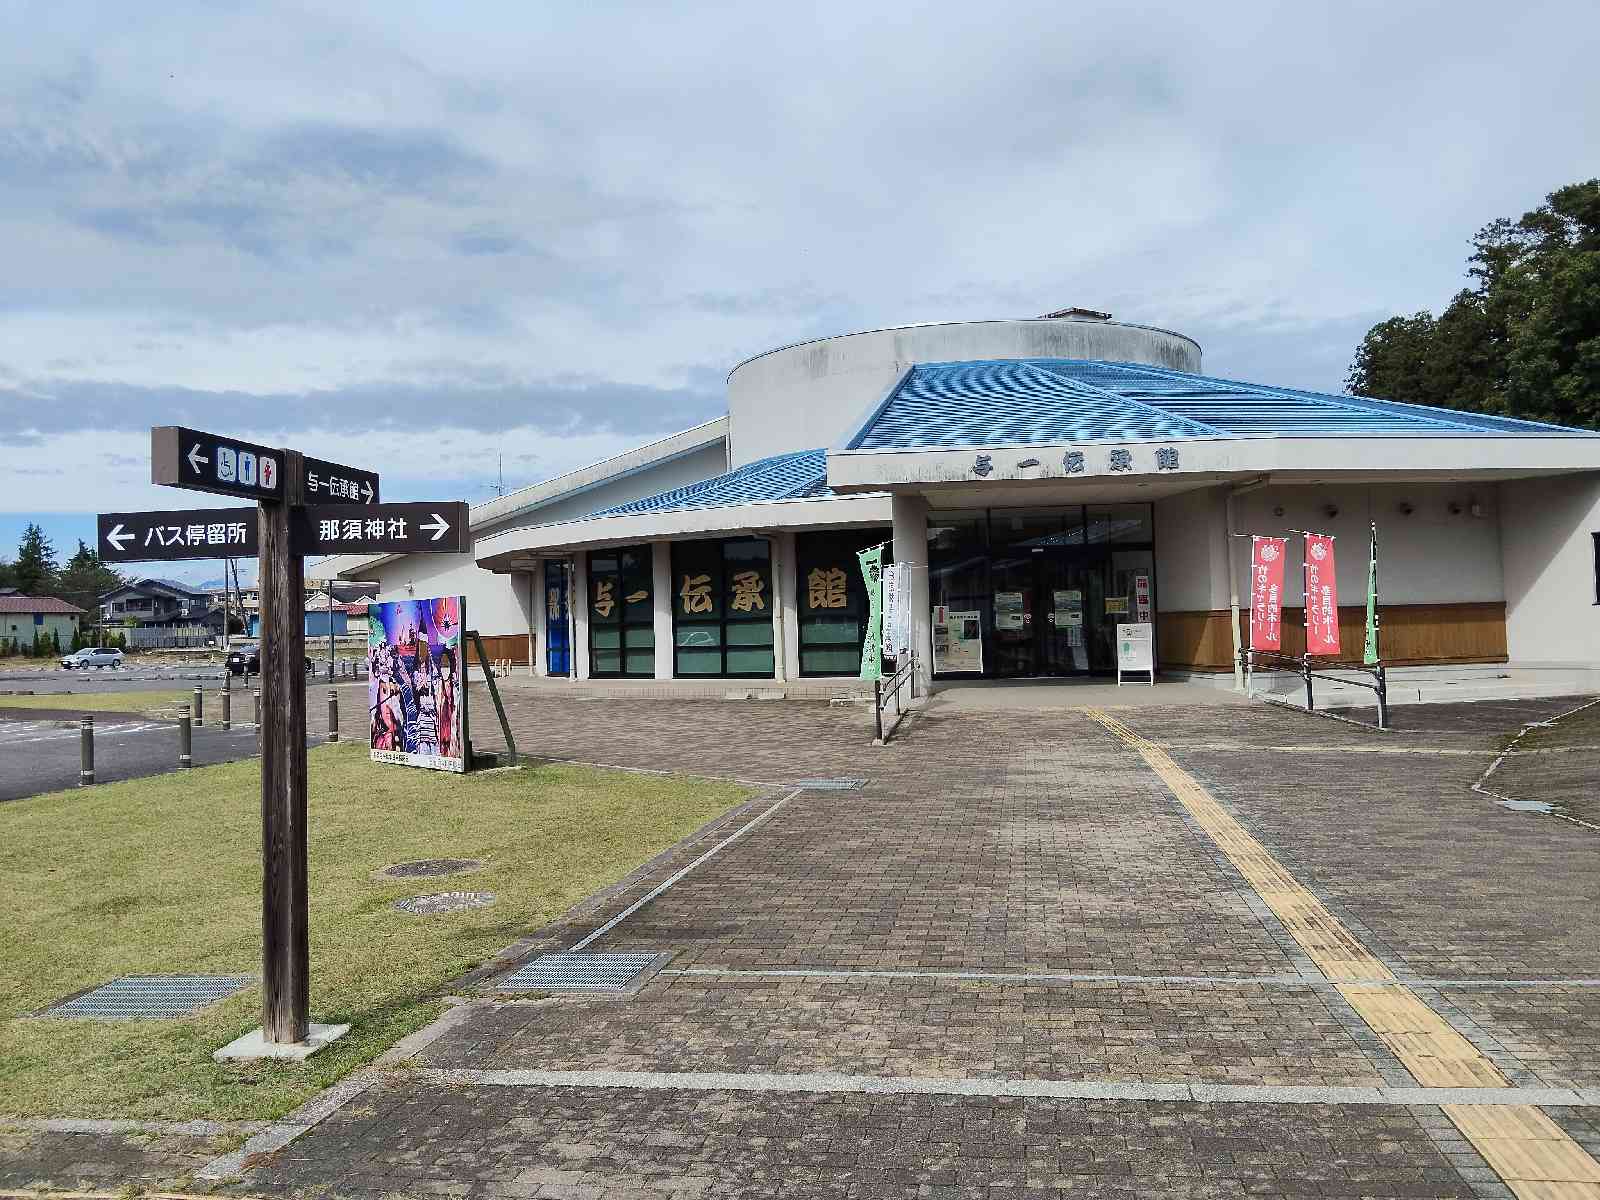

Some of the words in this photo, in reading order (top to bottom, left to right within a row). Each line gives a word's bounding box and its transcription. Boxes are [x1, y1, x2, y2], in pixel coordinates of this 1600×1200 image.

[971, 447, 1180, 477] 与一伝承館
[307, 471, 361, 501] 与一伝承館
[144, 522, 248, 547] バス停留所
[319, 518, 408, 541] 那須神社
[594, 567, 848, 617] 与一伝承館
